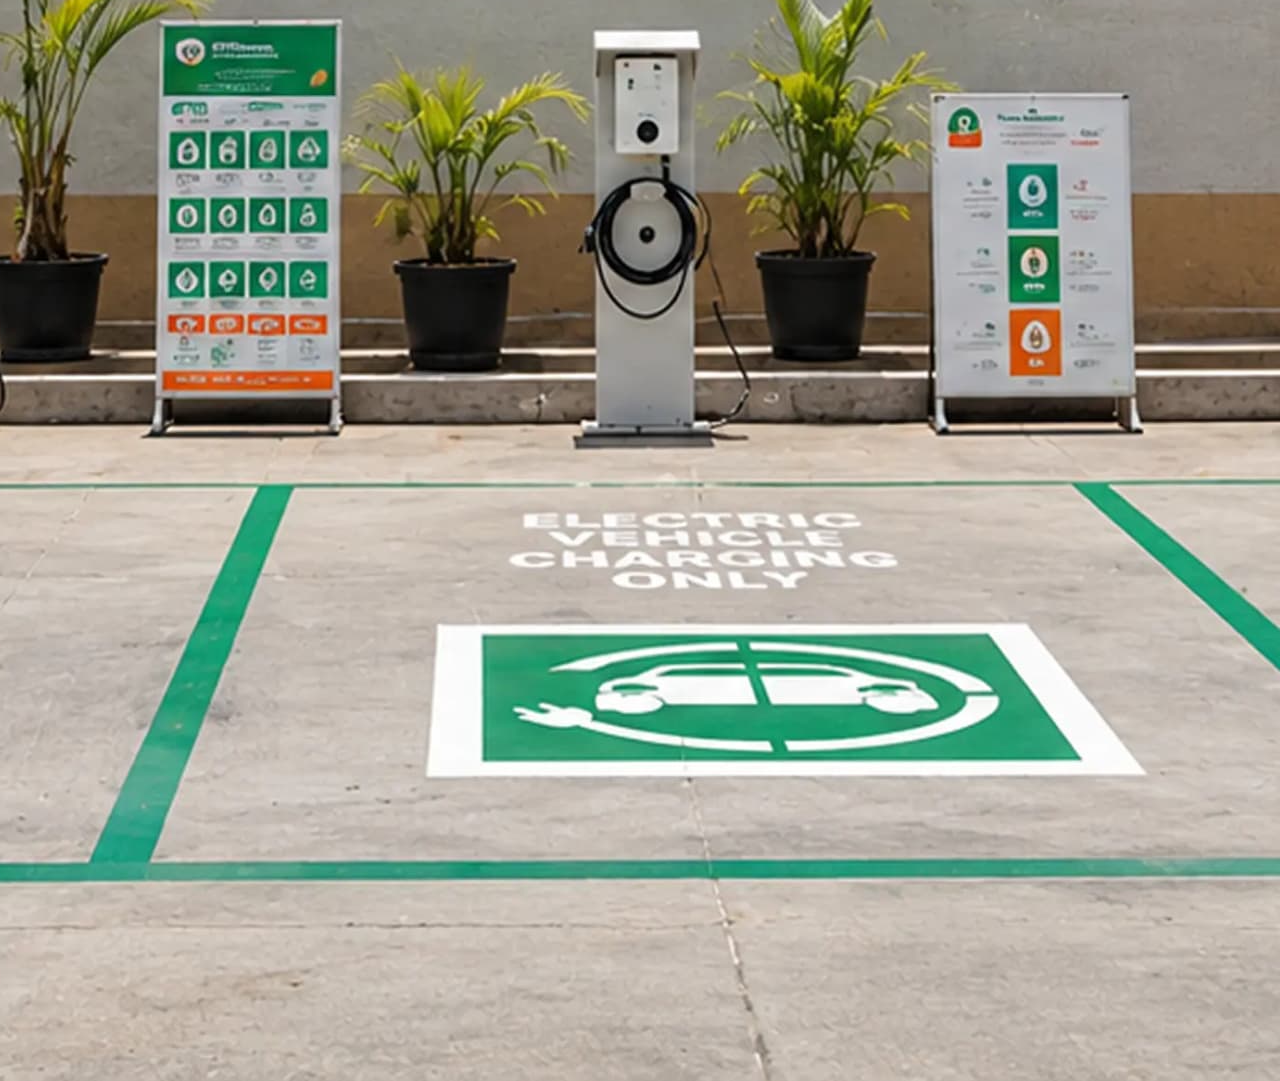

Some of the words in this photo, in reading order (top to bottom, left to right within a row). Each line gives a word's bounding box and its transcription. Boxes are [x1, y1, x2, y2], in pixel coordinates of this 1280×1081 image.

[522, 512, 862, 529] ELECTRIC
[548, 530, 843, 547] VEHICLE
[508, 550, 898, 568] CHARGING
[611, 571, 808, 589] ONLY
